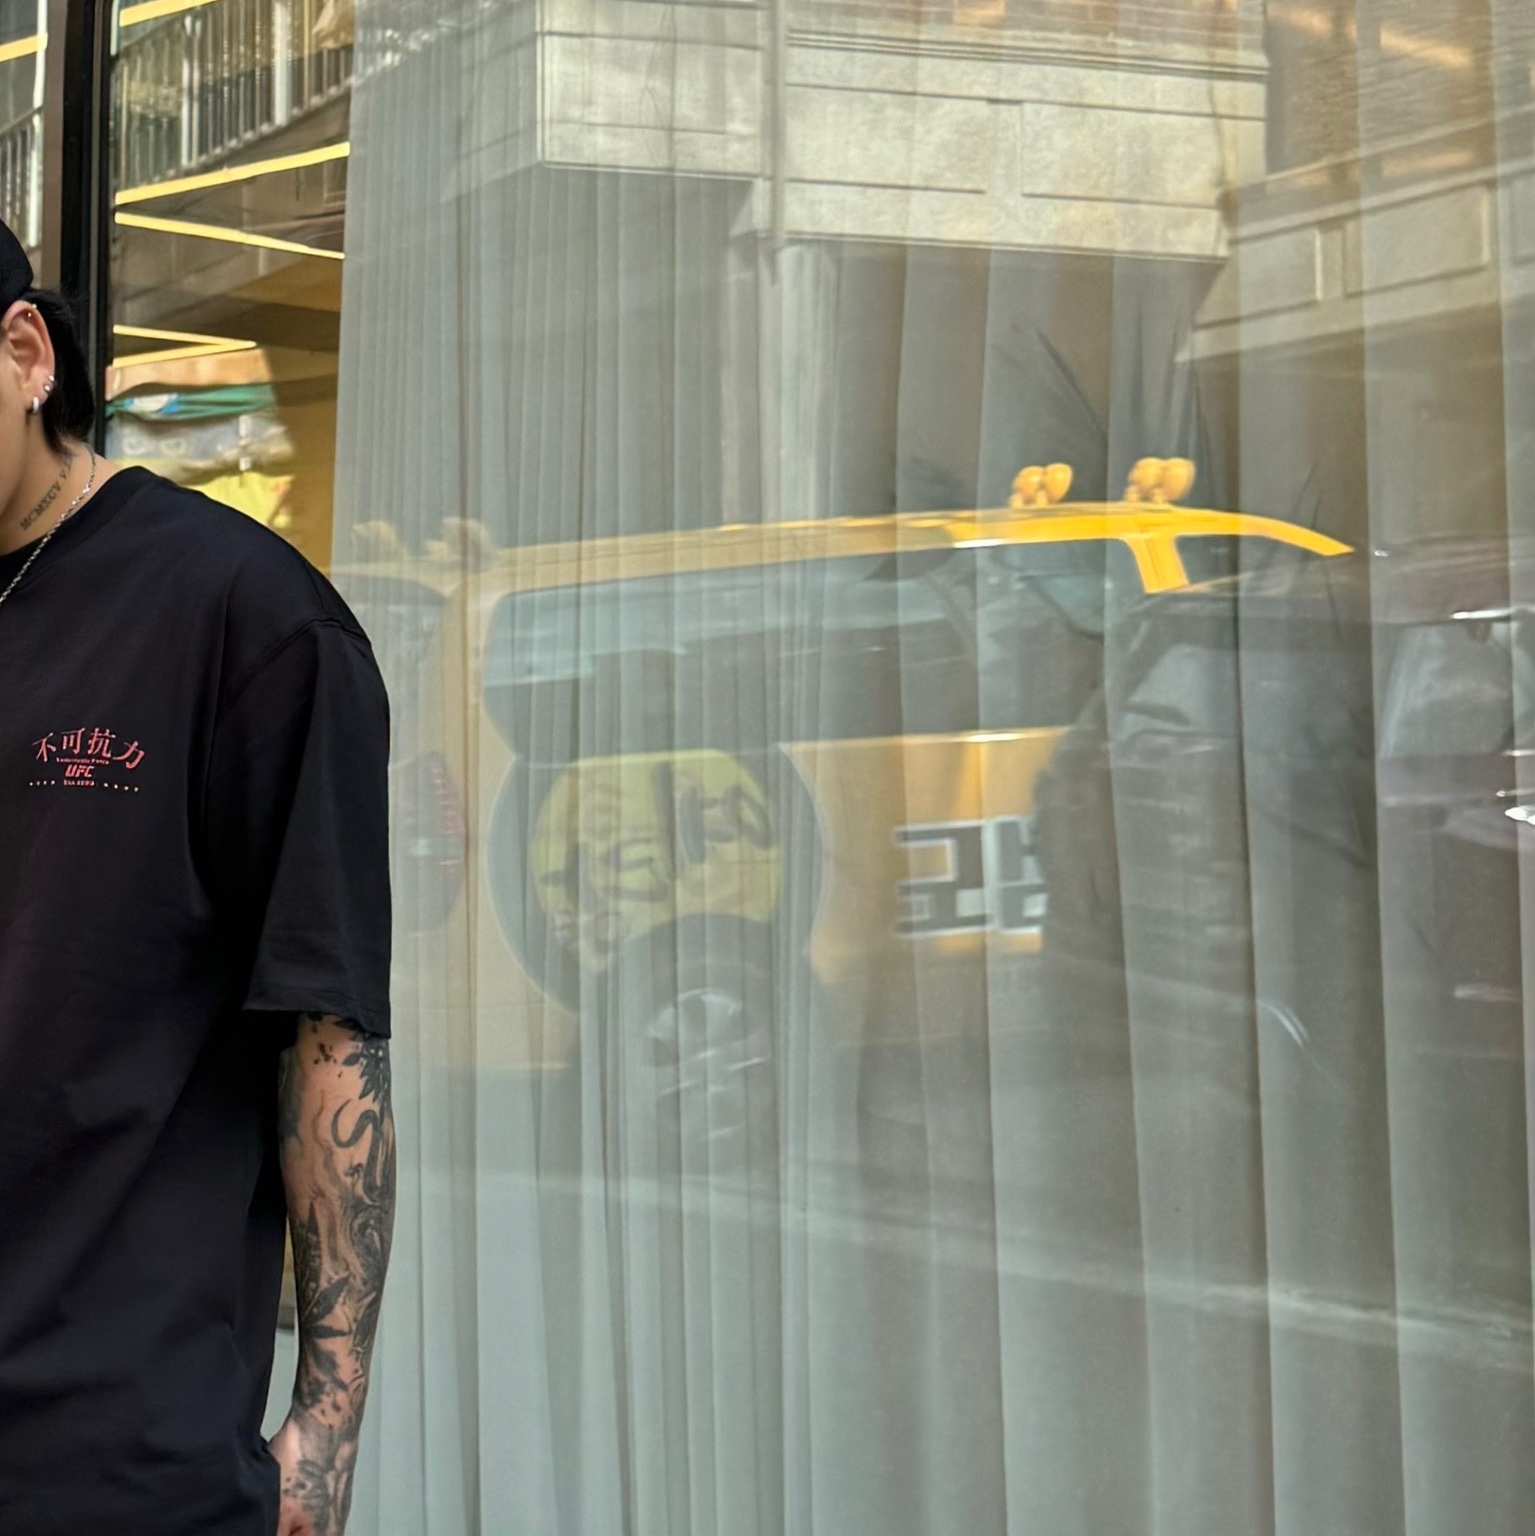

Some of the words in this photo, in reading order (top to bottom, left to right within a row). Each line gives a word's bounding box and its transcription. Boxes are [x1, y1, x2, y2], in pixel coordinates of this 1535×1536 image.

[31, 731, 145, 770] 不可抗力
[65, 764, 95, 778] UFC
